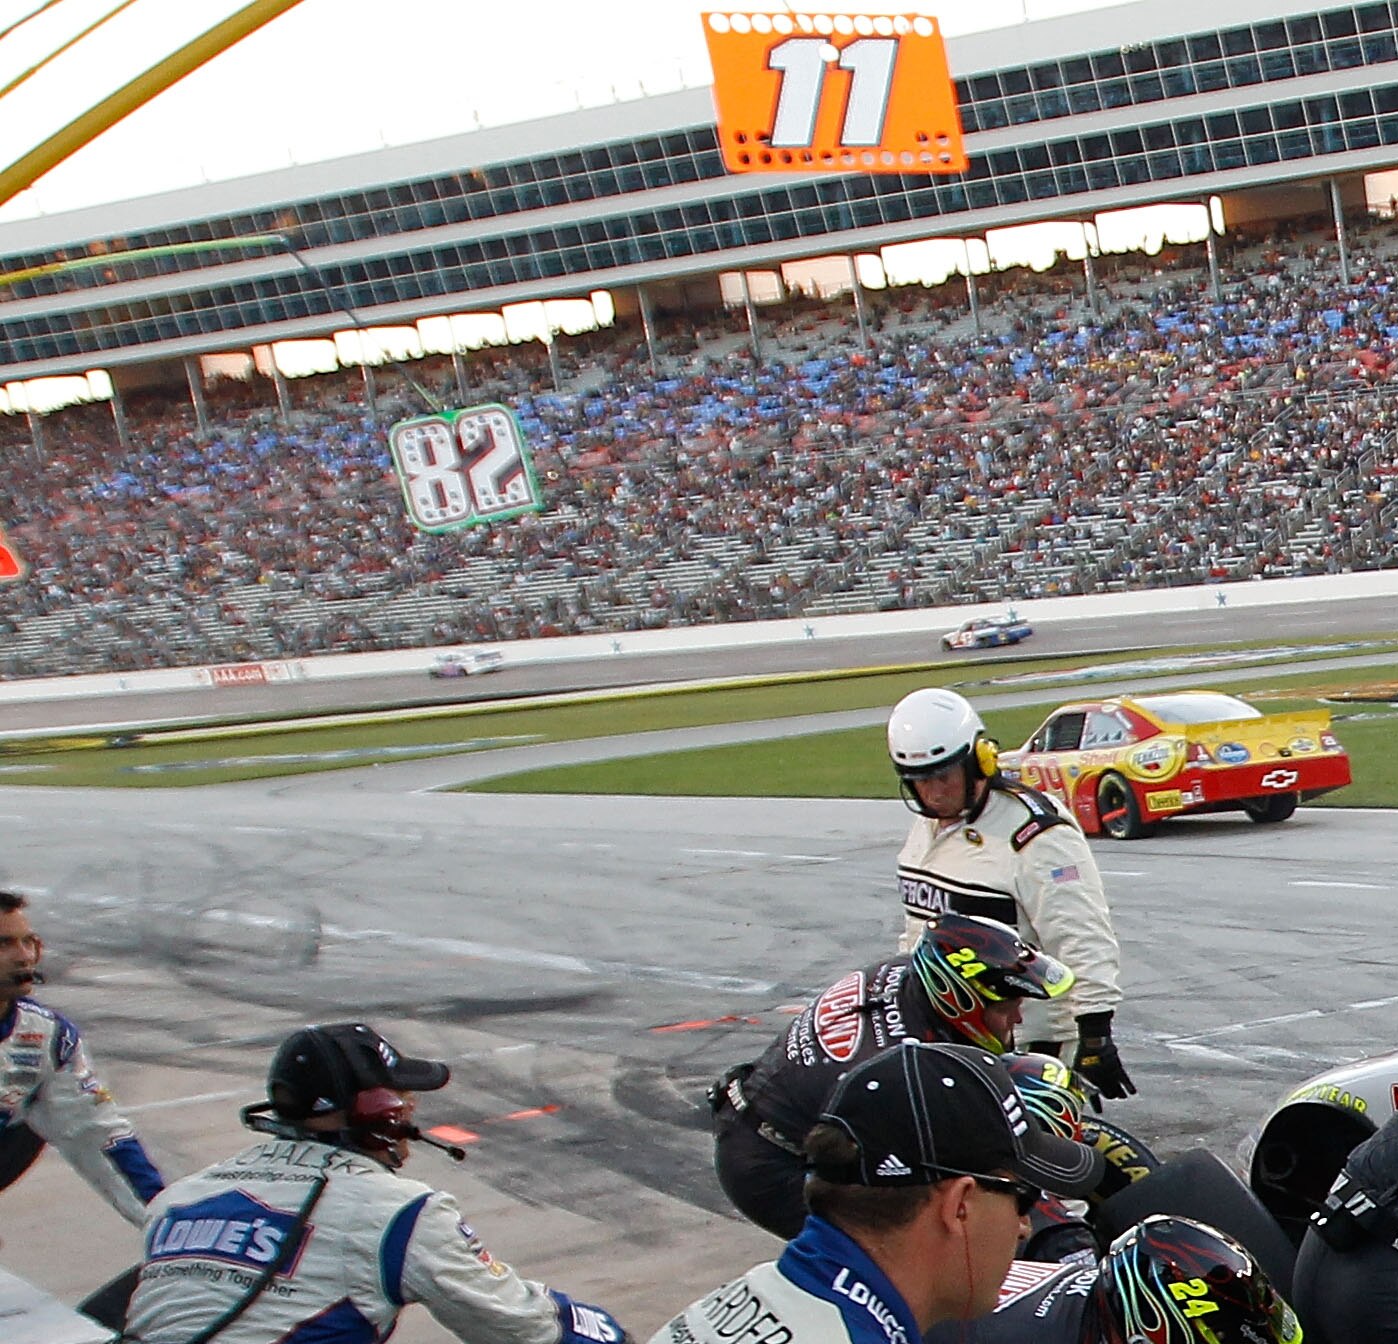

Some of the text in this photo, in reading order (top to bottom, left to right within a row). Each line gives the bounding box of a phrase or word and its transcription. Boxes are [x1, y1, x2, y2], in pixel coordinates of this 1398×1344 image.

[767, 36, 899, 148] 11
[396, 408, 533, 525] 82
[946, 947, 987, 980] 24
[151, 1217, 282, 1263] LOWE'S
[1167, 1277, 1219, 1319] 24
